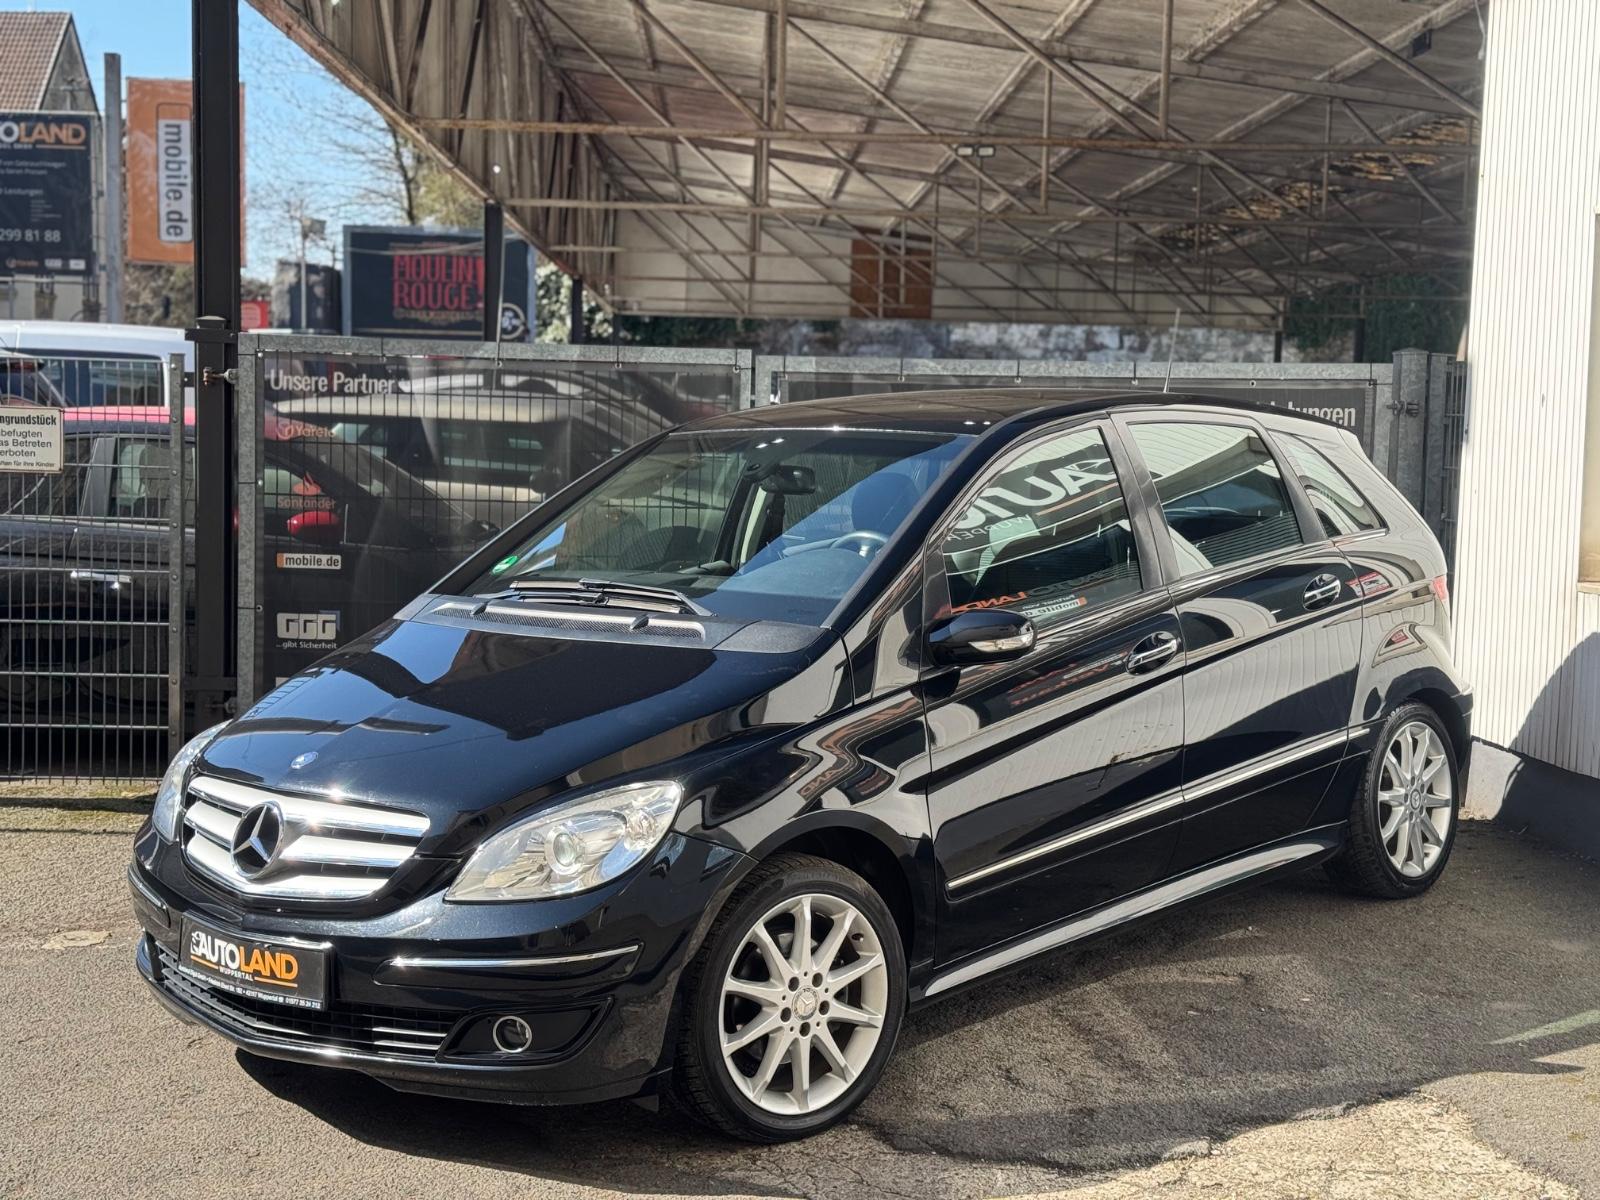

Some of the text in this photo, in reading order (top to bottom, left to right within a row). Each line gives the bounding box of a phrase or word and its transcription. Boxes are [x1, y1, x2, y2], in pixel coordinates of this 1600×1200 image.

[0, 121, 87, 145] OLAND
[164, 123, 189, 237] mobile.de
[0, 228, 61, 243] 299 81 88
[393, 253, 473, 281] MOULIN
[270, 368, 396, 395] Unsere Partner
[0, 414, 57, 425] ngrundstück
[1, 428, 43, 439] befugten
[12, 439, 52, 448] Betreten
[0, 448, 36, 457] erboten
[277, 497, 337, 509] Santander
[285, 555, 340, 567] mobile.de
[299, 641, 338, 650] Sicherheit
[196, 932, 299, 981] AUTOLAND
[218, 966, 254, 982] WUPPERTAL
